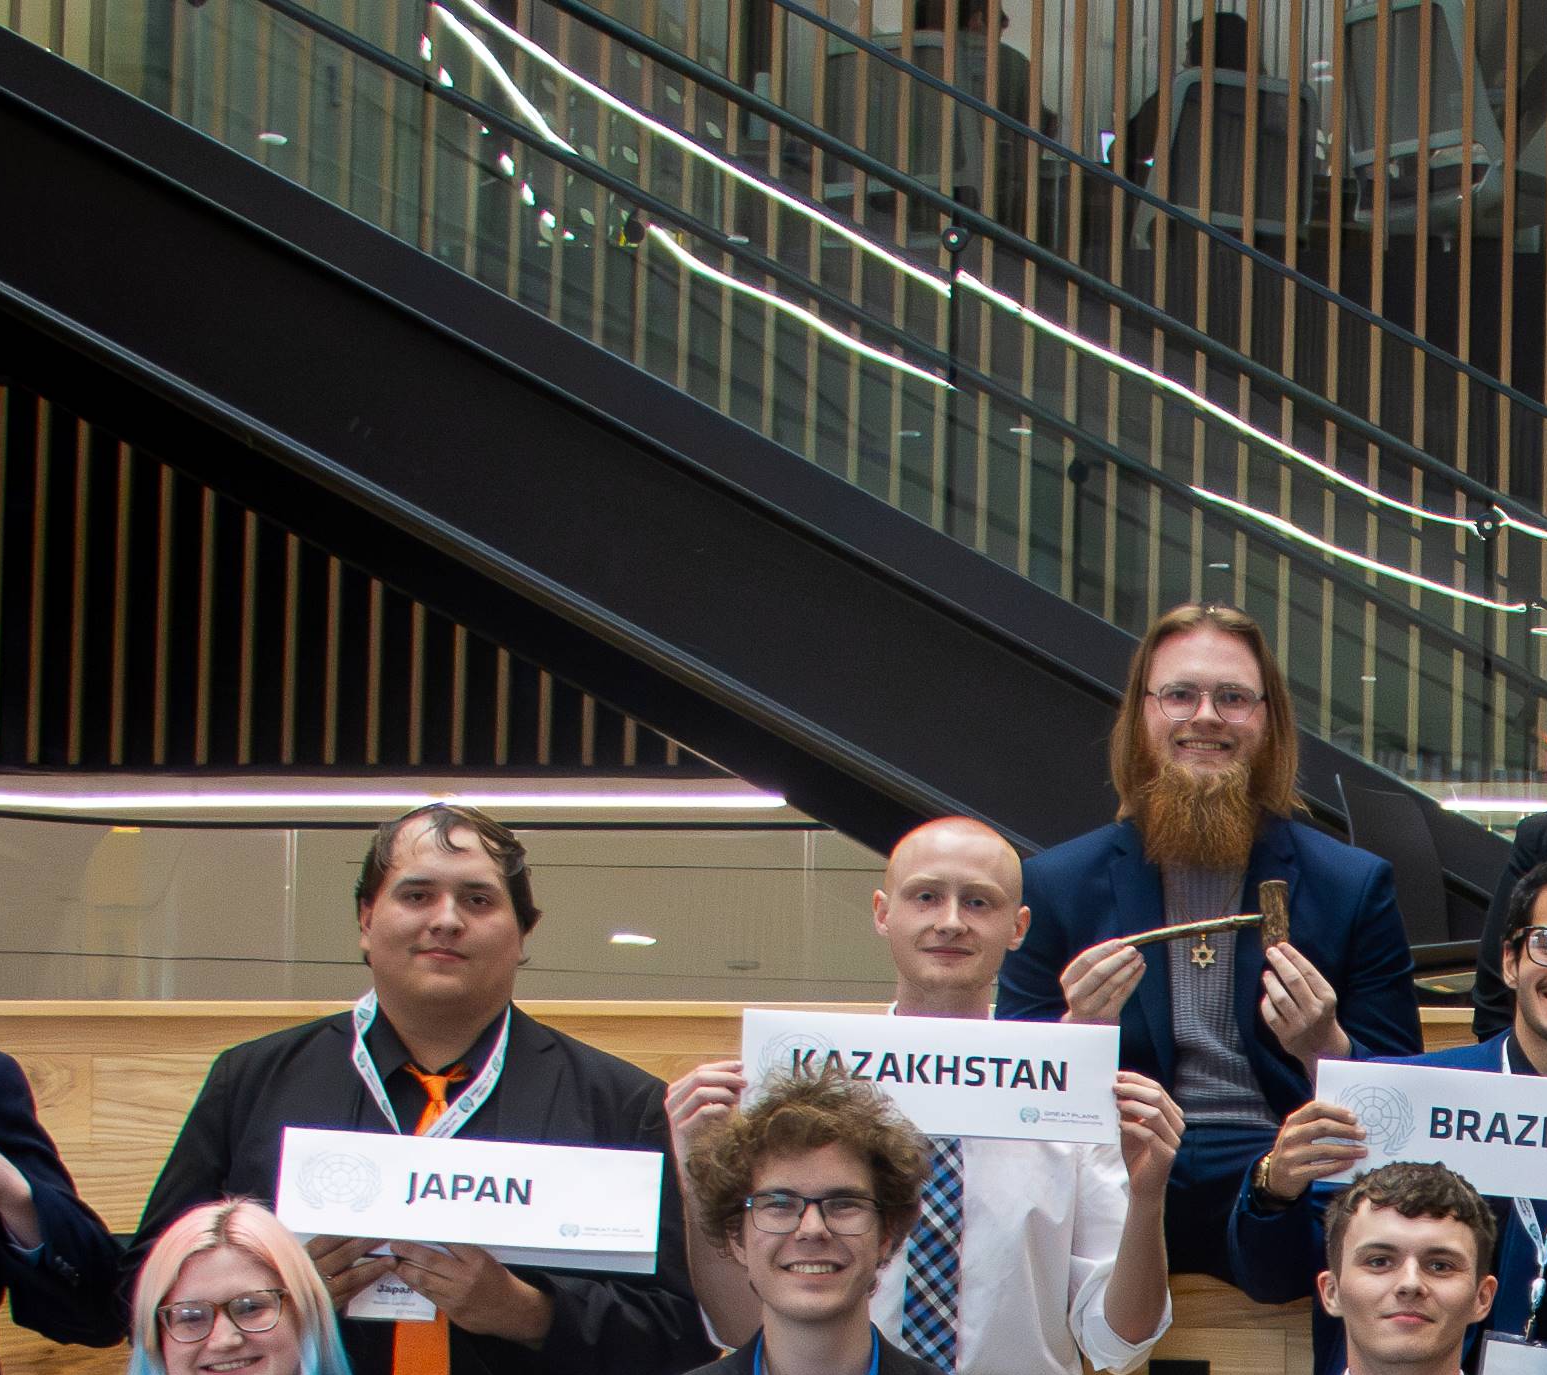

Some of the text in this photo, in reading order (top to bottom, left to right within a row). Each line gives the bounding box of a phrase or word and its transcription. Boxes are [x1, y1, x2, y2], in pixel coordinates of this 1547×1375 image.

[790, 1048, 1068, 1092] KAZAKHSTAN
[405, 1172, 533, 1206] JAPAN
[376, 1283, 413, 1296] Japan
